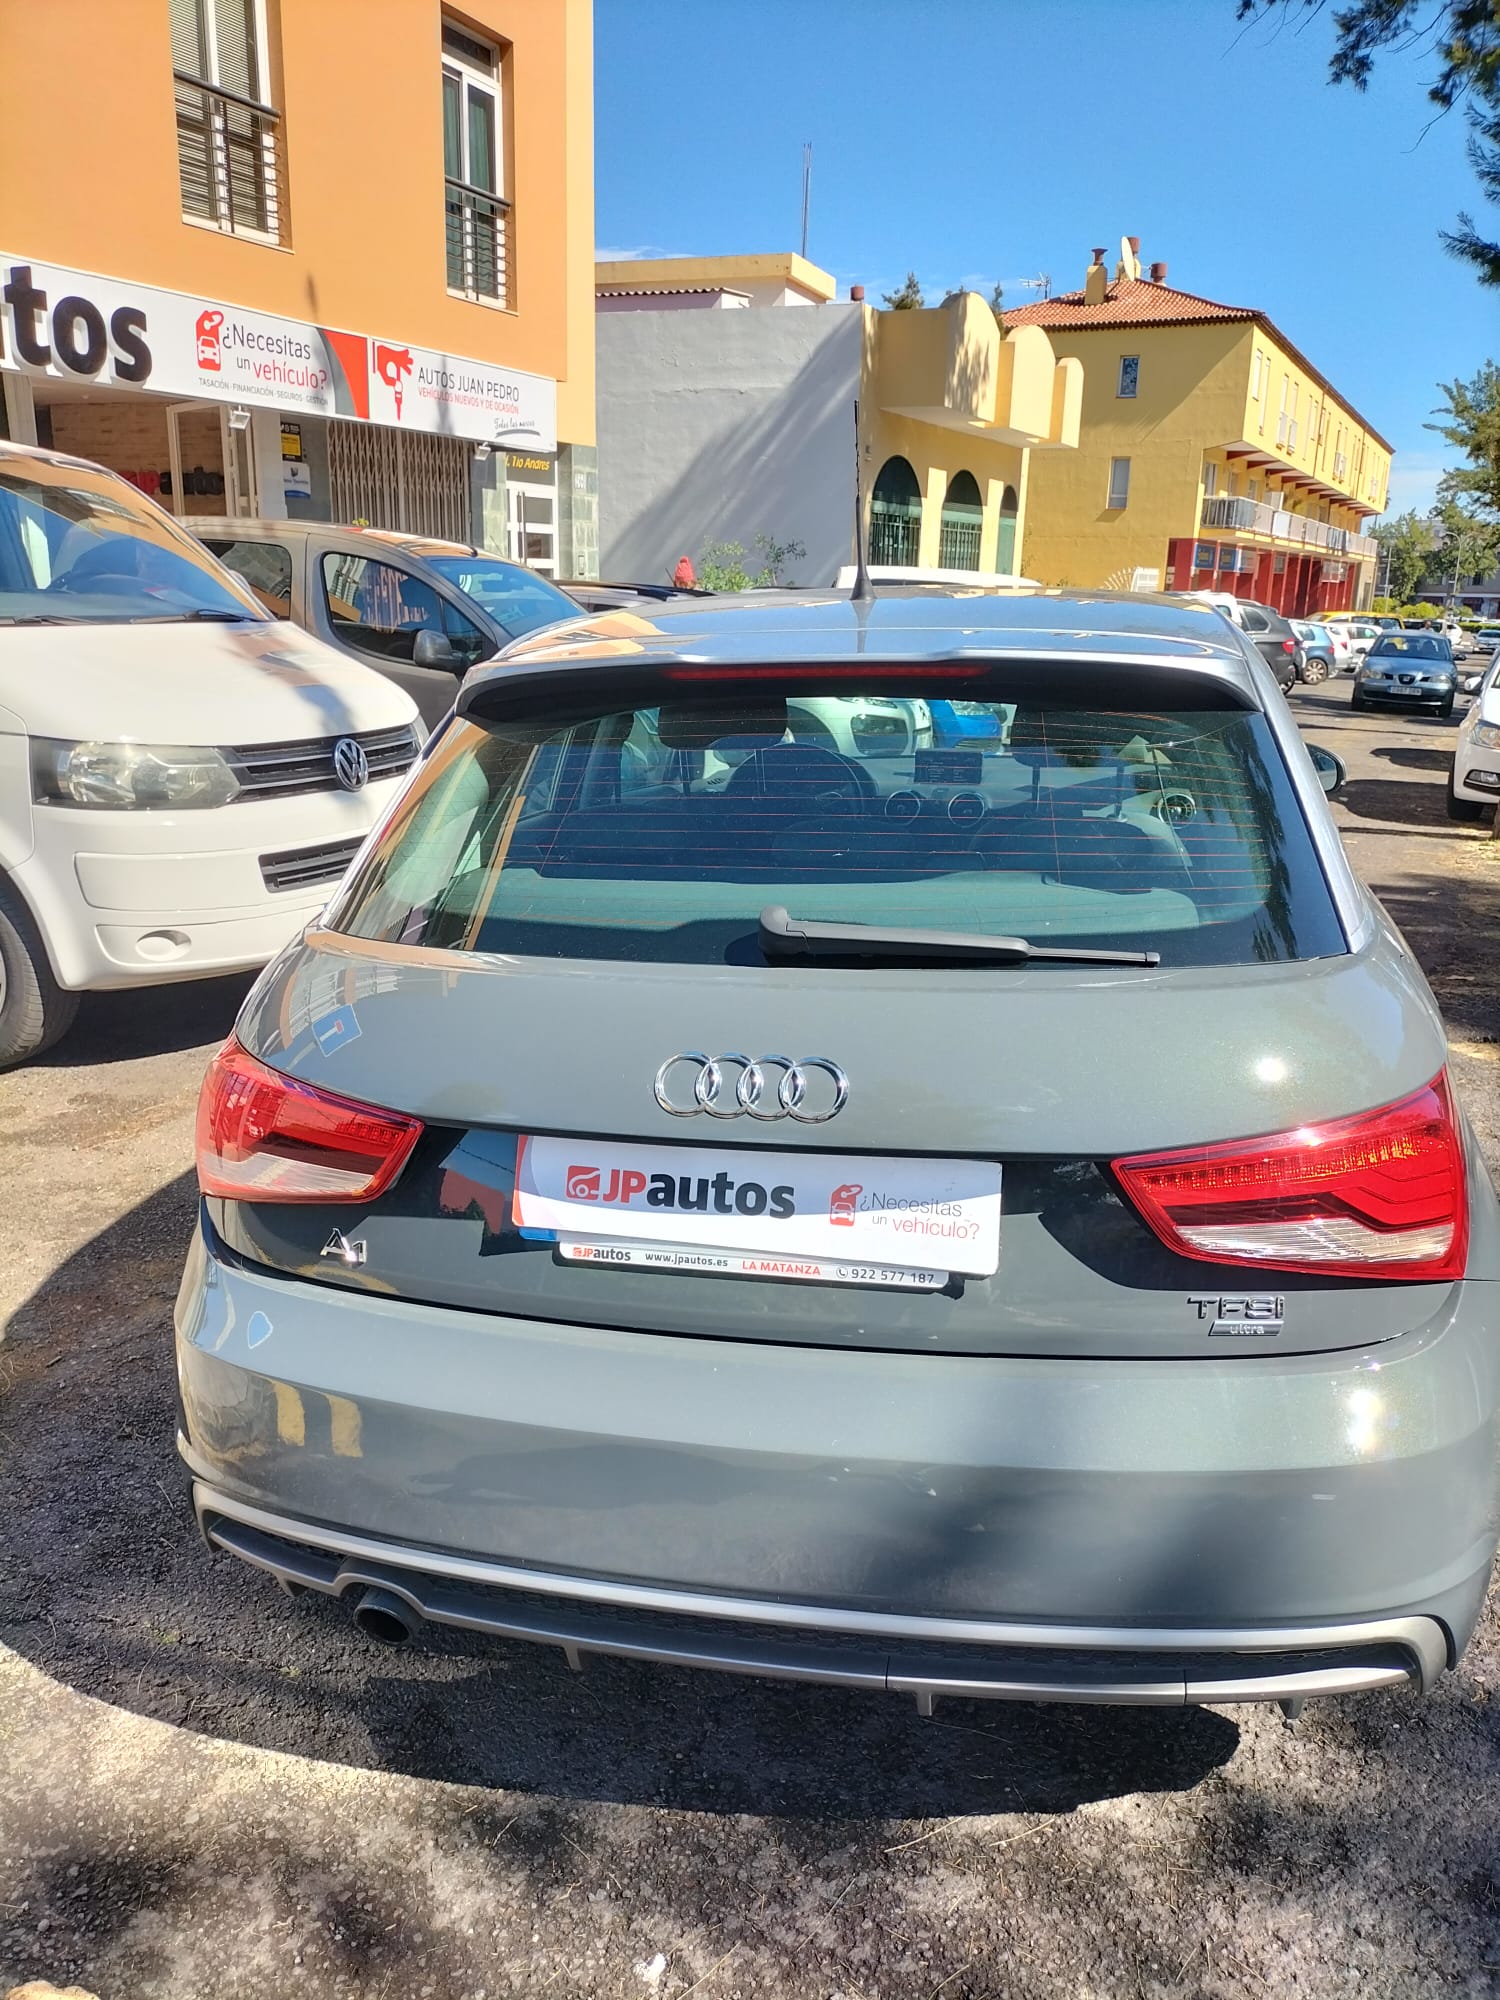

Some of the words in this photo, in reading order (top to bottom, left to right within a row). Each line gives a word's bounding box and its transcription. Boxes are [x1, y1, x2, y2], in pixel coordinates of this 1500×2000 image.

[0, 265, 152, 382] tos
[222, 323, 311, 360] ¿Necesitas
[198, 377, 229, 391] TASACIÓN
[232, 383, 274, 397] FINANCIACIÓN
[276, 390, 303, 402] SEGUROS
[236, 356, 251, 370] un
[253, 359, 328, 390] vehículo?
[418, 367, 455, 390] AUTOS
[457, 375, 484, 395] JUAN
[487, 381, 520, 402] PEDRO
[454, 394, 479, 407] NUEVOS
[485, 400, 494, 410] DE
[494, 401, 519, 414] OCASIÓN
[602, 1168, 796, 1220] JPautos
[859, 1191, 963, 1218] ¿Necesitas
[871, 1214, 888, 1226] un
[892, 1217, 980, 1240] vehículo?
[320, 1227, 368, 1264] A1
[582, 1247, 631, 1262] JPautos
[644, 1251, 729, 1268] www.jpautos.es
[742, 1260, 757, 1271] LA
[760, 1261, 821, 1276] MATANZA
[851, 1268, 876, 1280] 922
[880, 1270, 905, 1282] 577
[911, 1272, 935, 1284] 187
[1186, 1295, 1285, 1320] TFSI
[1229, 1323, 1265, 1335] ultra
